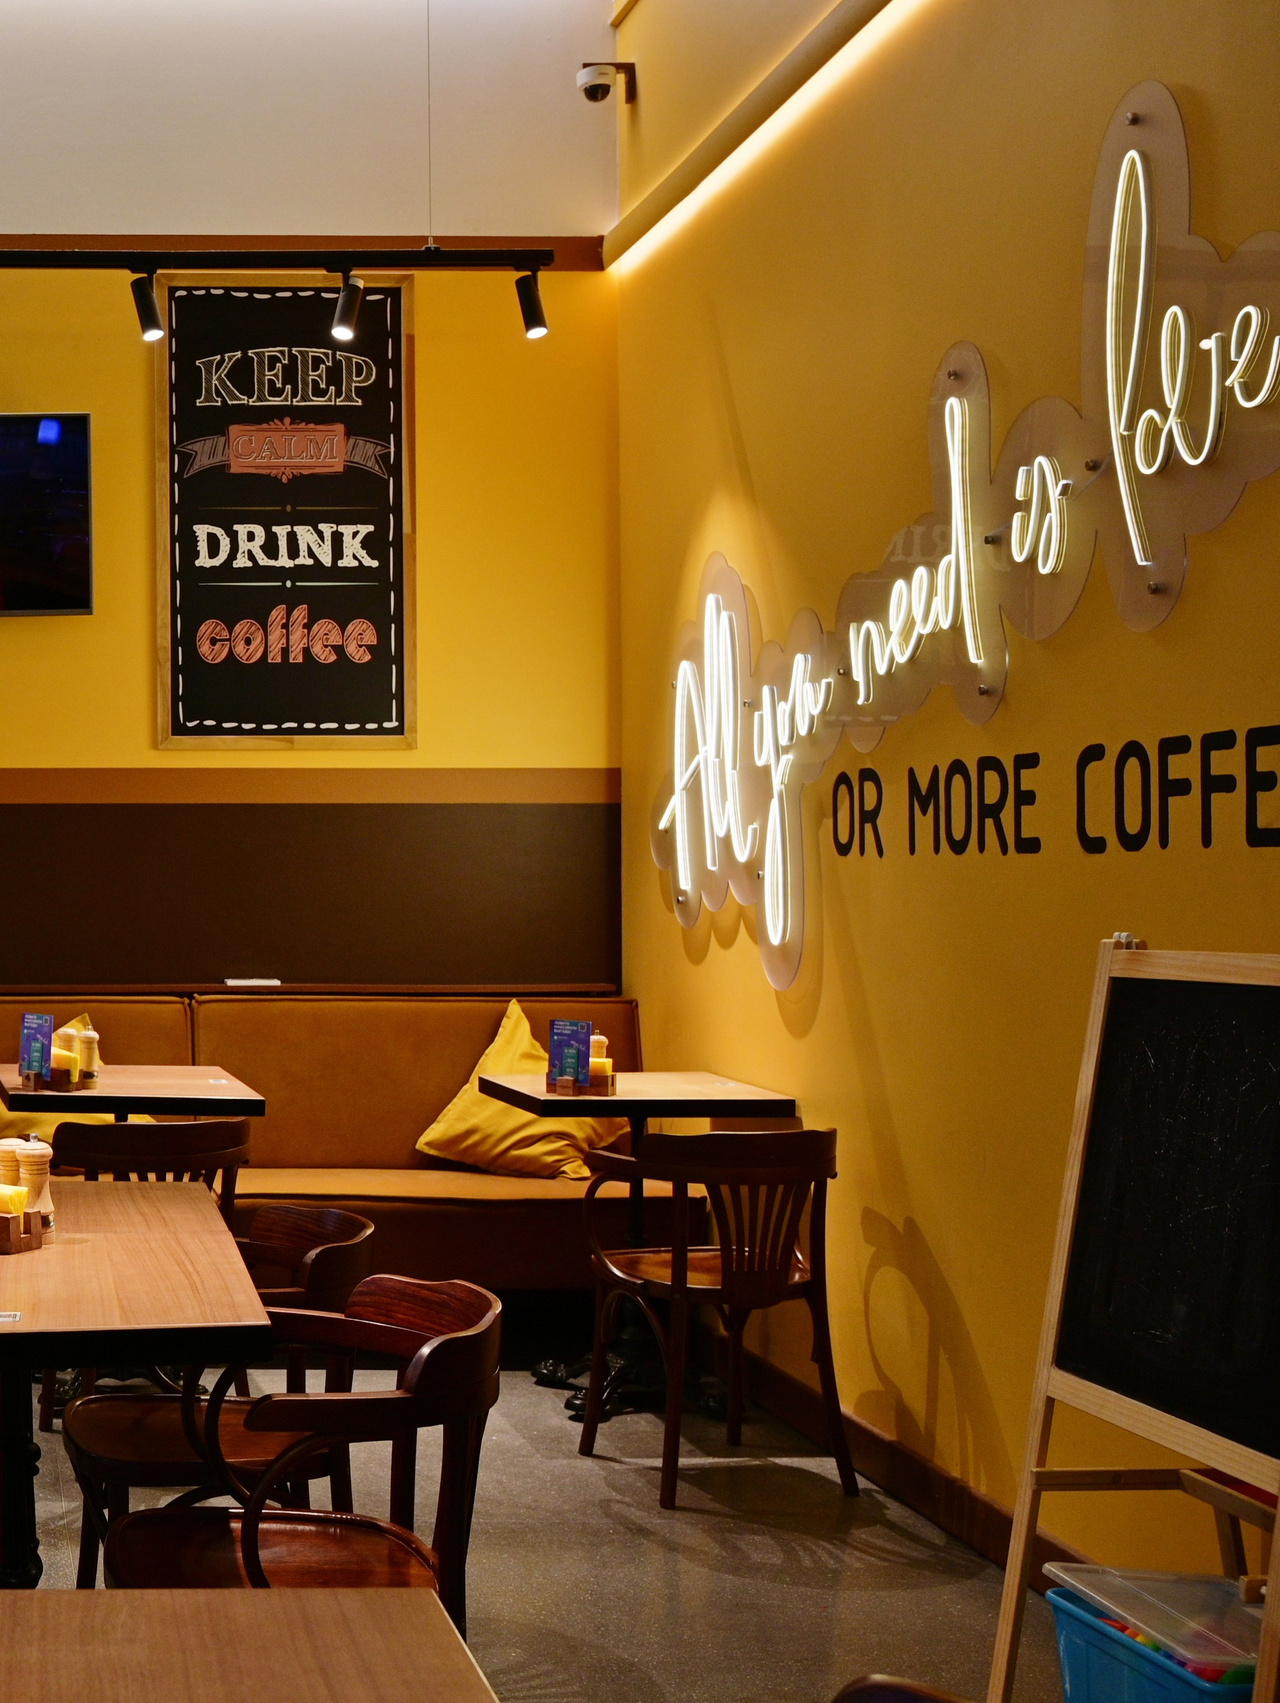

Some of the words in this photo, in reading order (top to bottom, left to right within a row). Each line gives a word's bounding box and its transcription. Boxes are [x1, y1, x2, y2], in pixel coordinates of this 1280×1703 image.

[195, 347, 377, 406] KEEP
[232, 434, 339, 462] CALM
[192, 523, 380, 568] DRINK
[658, 593, 760, 890] All
[753, 653, 834, 946] you
[849, 397, 984, 706] need
[1012, 455, 1074, 575] is
[1106, 149, 1280, 567] love
[196, 604, 378, 664] coffee
[832, 768, 884, 859] OR
[907, 752, 1042, 857] MORE
[1076, 724, 1280, 854] COFFE
